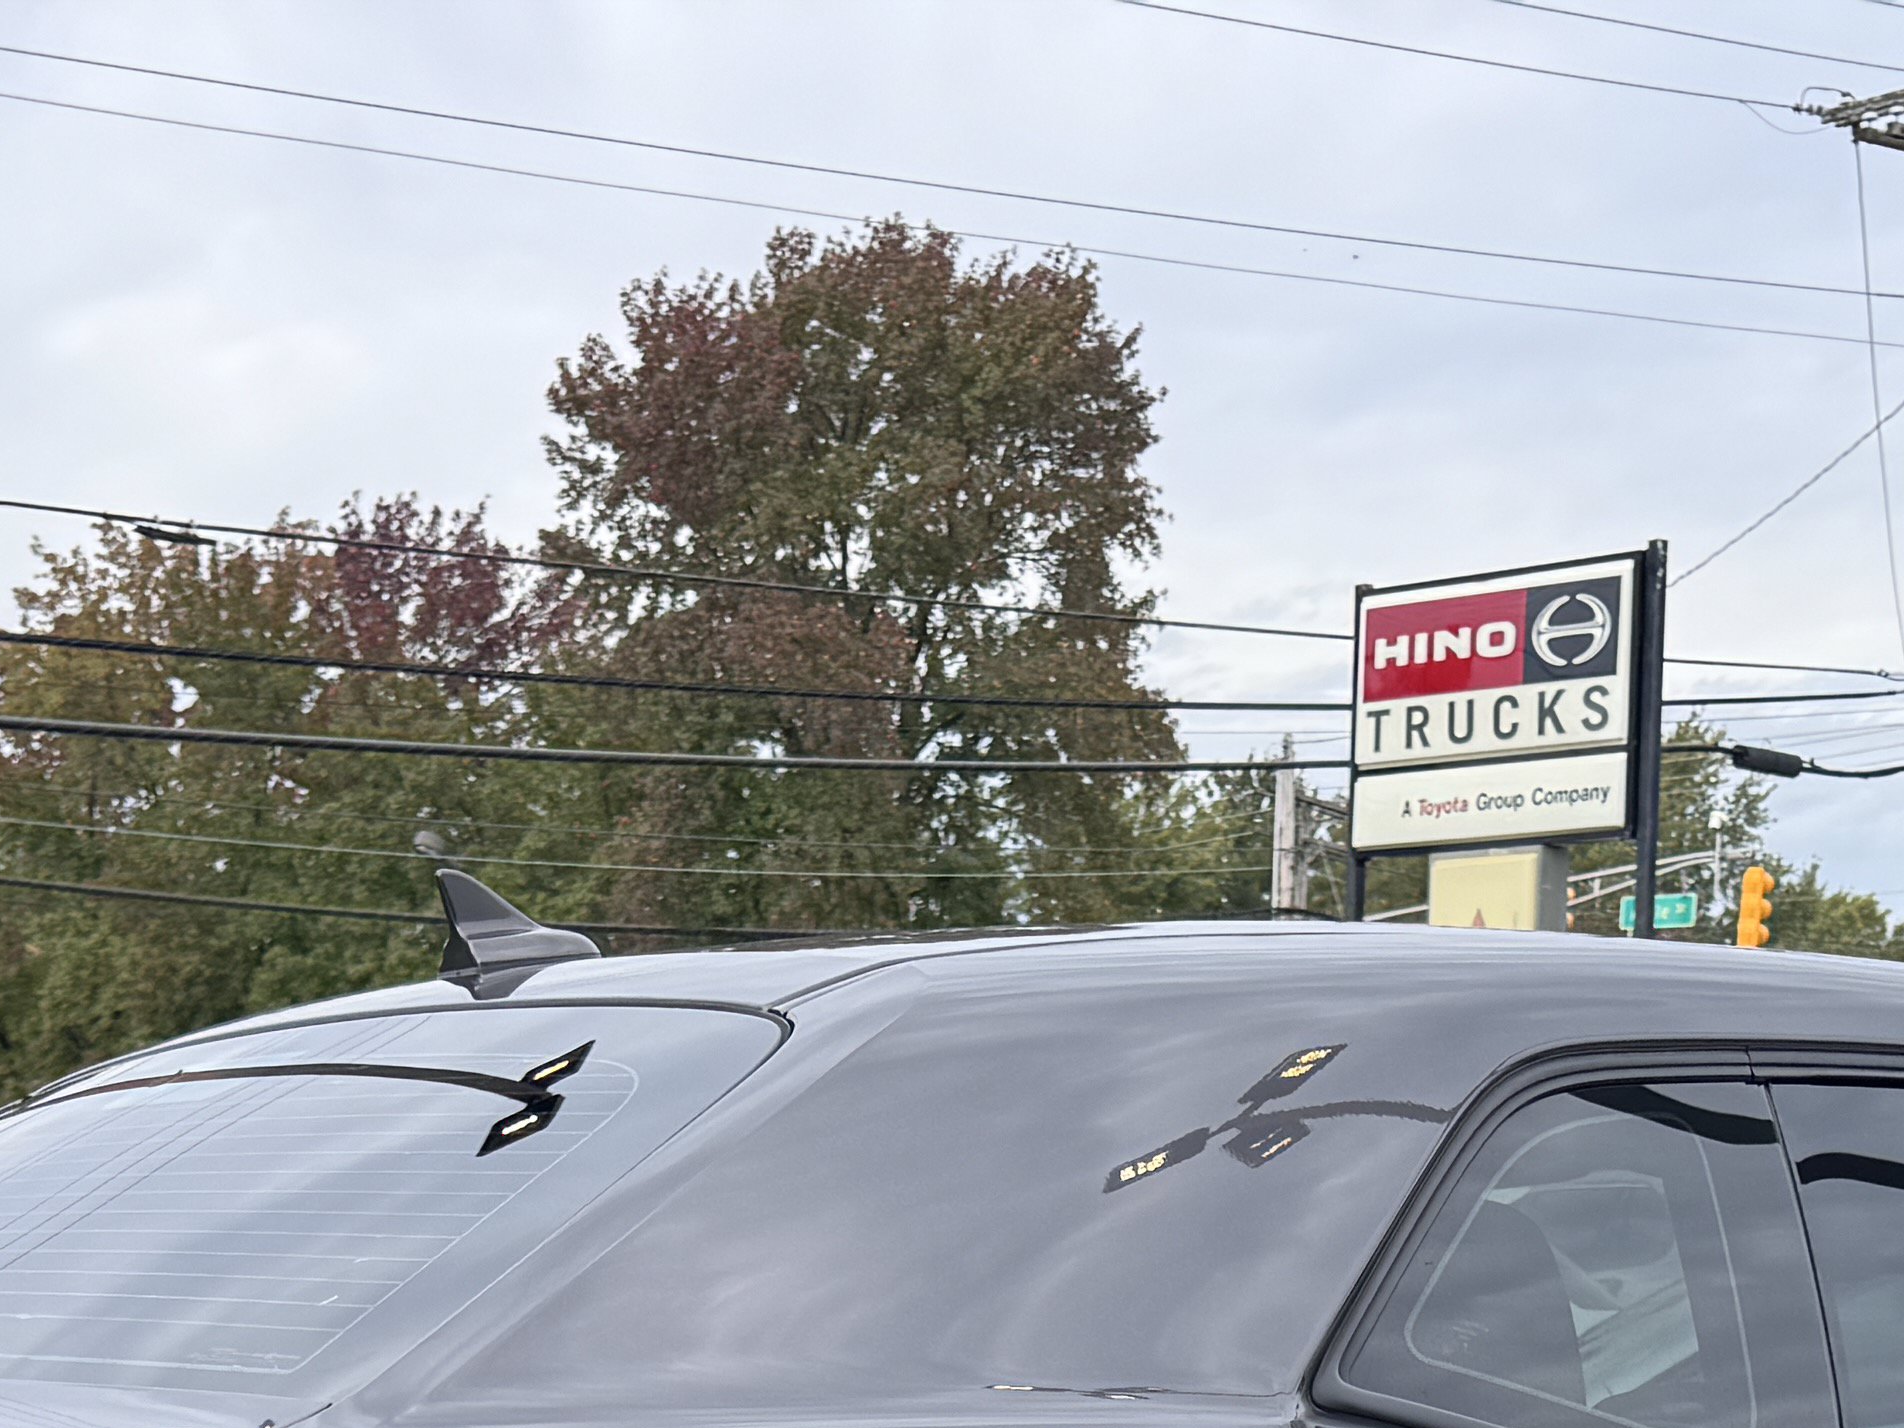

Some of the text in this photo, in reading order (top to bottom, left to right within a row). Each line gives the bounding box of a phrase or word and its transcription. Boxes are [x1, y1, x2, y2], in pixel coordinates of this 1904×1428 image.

[1374, 621, 1516, 669] HINO
[1366, 685, 1611, 752] TRUCKS
[1401, 786, 1611, 819] A Toyota Group Company
